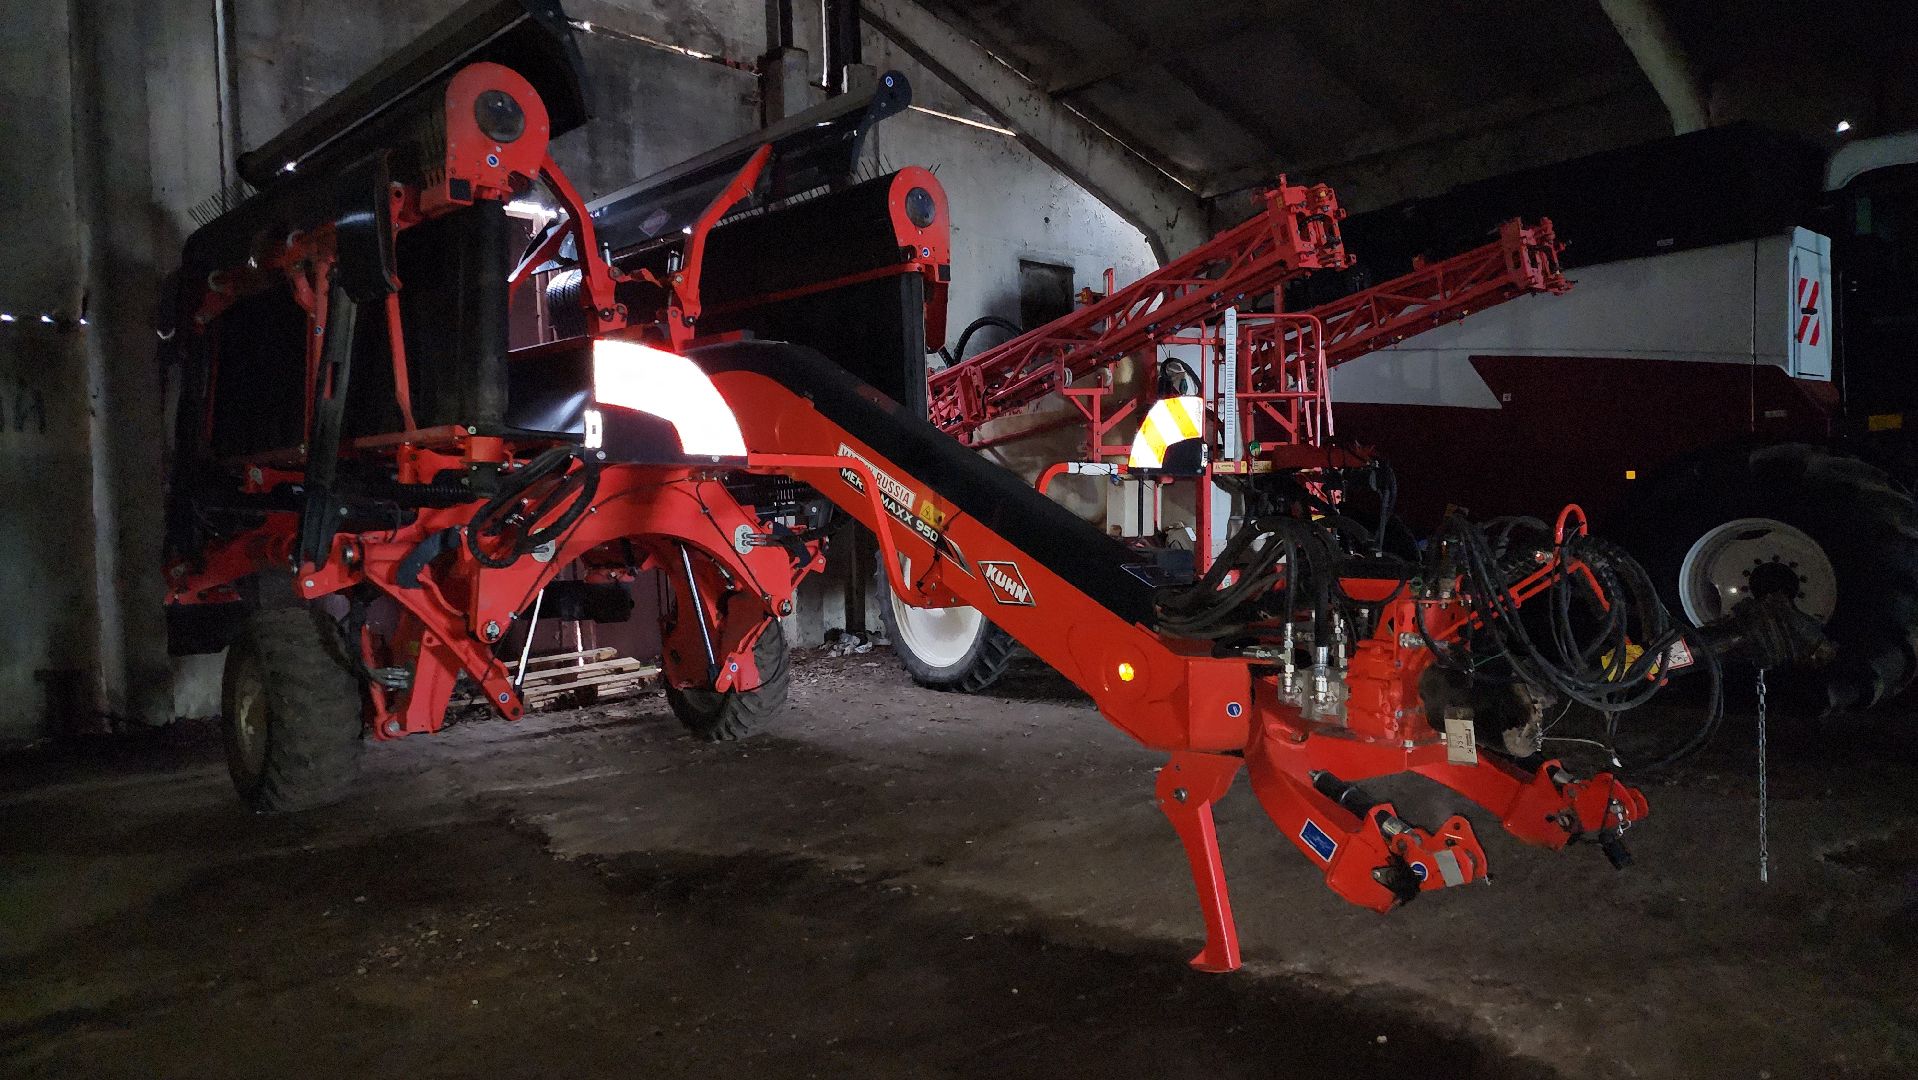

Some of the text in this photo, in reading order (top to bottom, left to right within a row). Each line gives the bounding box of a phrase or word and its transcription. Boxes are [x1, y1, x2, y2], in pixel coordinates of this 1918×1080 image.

[876, 472, 910, 504] RUSSIA
[880, 493, 914, 525] MAXX
[915, 519, 939, 543] 950
[985, 563, 1028, 603] KUHN
